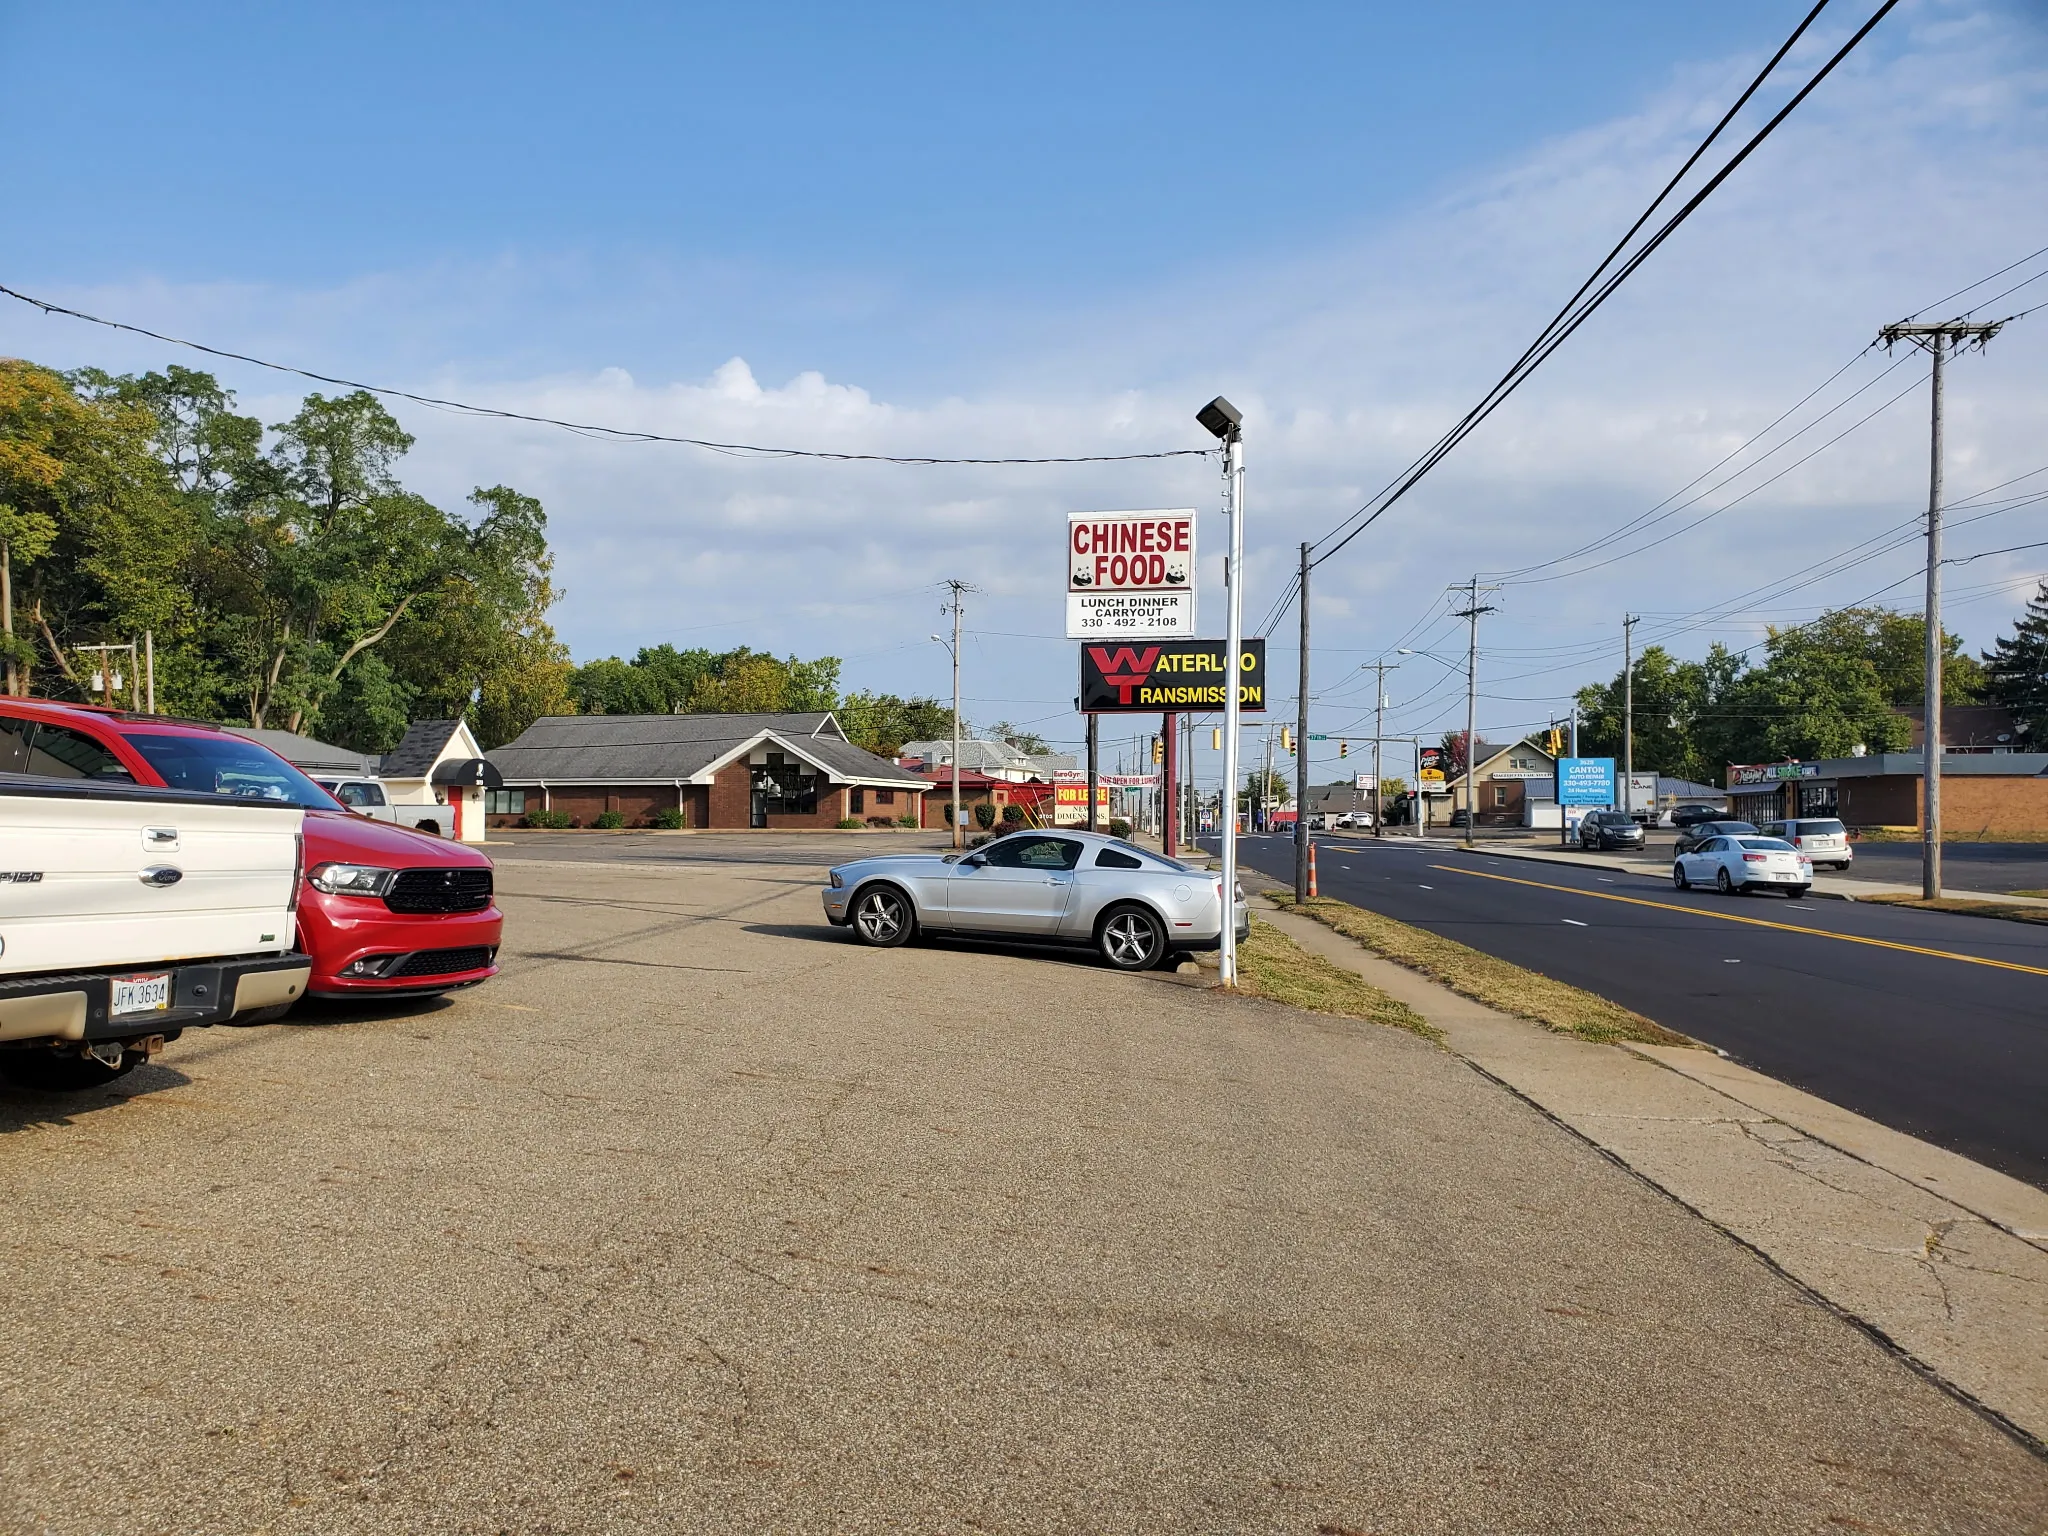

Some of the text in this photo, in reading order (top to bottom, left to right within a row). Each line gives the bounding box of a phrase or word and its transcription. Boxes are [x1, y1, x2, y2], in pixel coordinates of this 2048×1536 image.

[1073, 521, 1190, 554] CHINESE
[1095, 554, 1165, 586] FOOD
[1081, 597, 1178, 607] LUNCH DINNER
[1095, 607, 1163, 617] CARRYOUT
[1081, 618, 1103, 627] 330
[1113, 618, 1136, 627] 492
[1147, 617, 1177, 626] 2108
[1087, 646, 1256, 674] WATERLO
[1104, 675, 1261, 704] TRANSMISSON
[1569, 766, 1605, 774] CANTON
[1113, 776, 1128, 784] OPEN
[1130, 776, 1140, 784] FOR
[1142, 776, 1160, 784] LUNCH
[1058, 788, 1106, 801] FOR LESE
[113, 983, 165, 1007] JFK 3634
